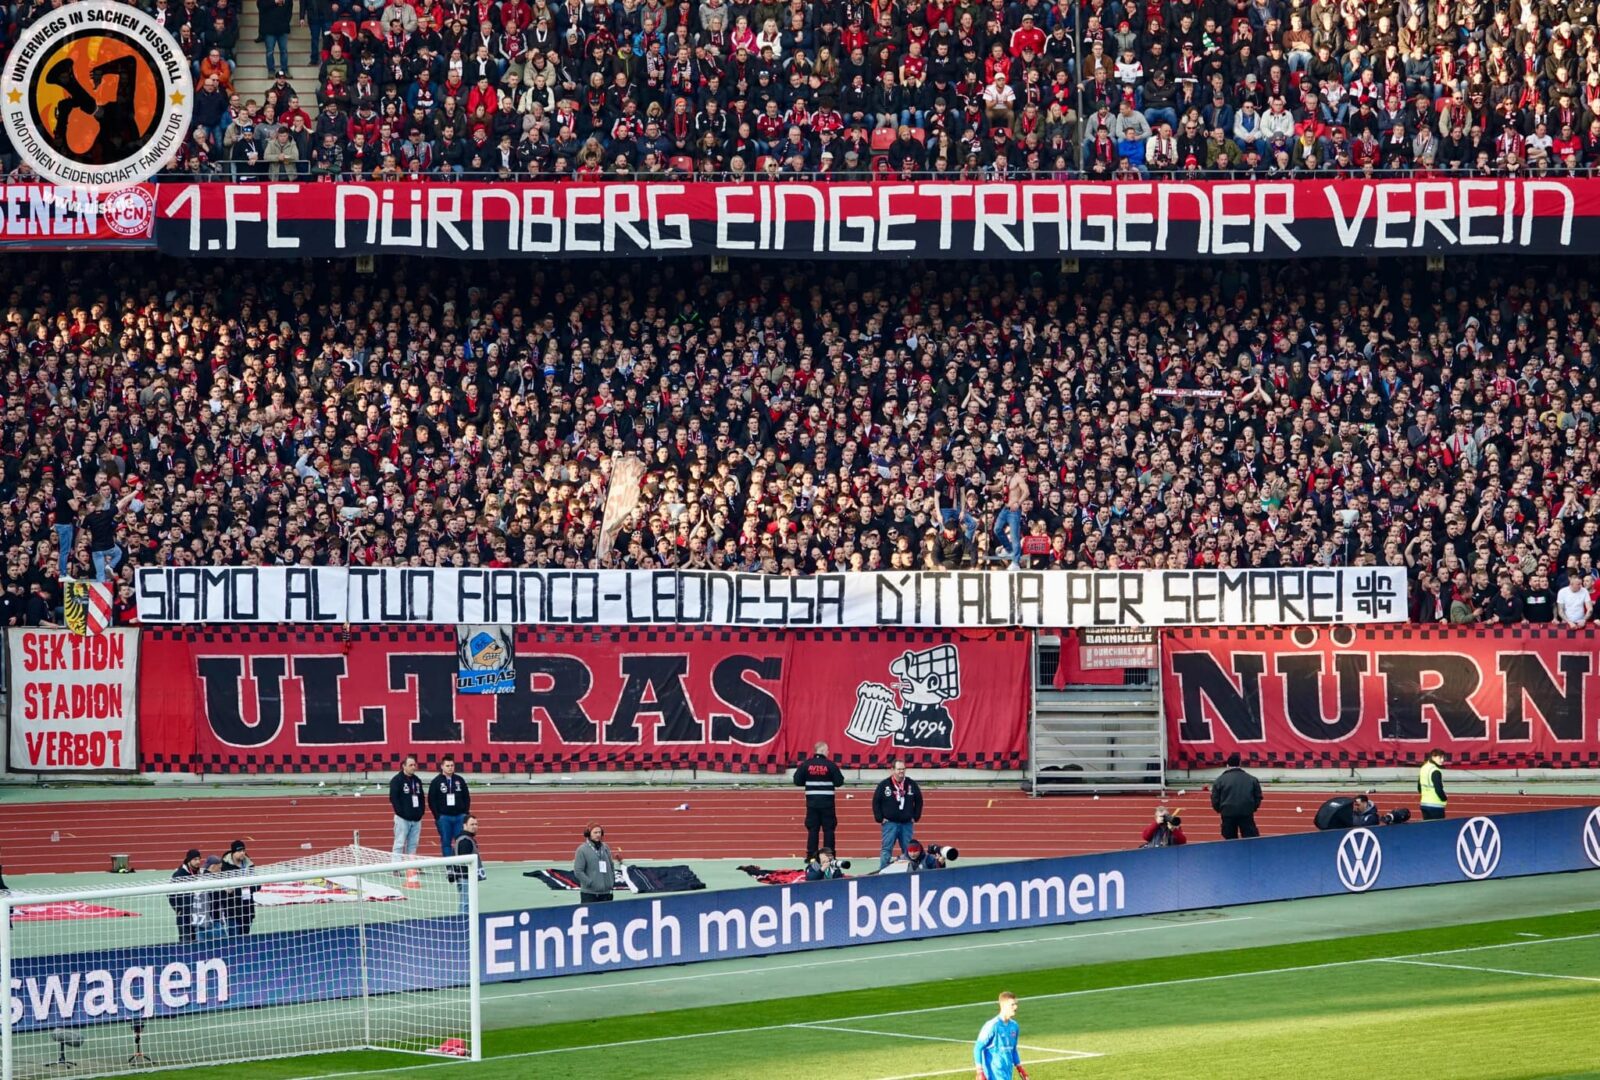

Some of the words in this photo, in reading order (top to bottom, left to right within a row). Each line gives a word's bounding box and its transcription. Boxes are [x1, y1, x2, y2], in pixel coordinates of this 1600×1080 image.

[0, 186, 98, 234] ENEN
[335, 183, 693, 252] NÜRNBERG
[715, 183, 1301, 253] EINGETRAGENER
[1323, 181, 1574, 247] VEREIN
[139, 568, 259, 620] SIAMO
[285, 568, 337, 620] AL
[349, 569, 434, 621] TUO
[1067, 571, 1145, 625] PER
[1163, 570, 1344, 623] SEMPRE!
[22, 632, 124, 671] SEKTION
[196, 652, 783, 747] ULTRAS
[457, 669, 516, 688] ULTRAS
[496, 685, 516, 693] 2002
[1171, 626, 1600, 744] NÜRN
[24, 682, 122, 720] STADION
[25, 730, 122, 767] VERBOT
[910, 719, 947, 739] 1994
[485, 900, 681, 975] Einfach
[699, 887, 833, 953] mehr
[848, 869, 1125, 938] bekommen
